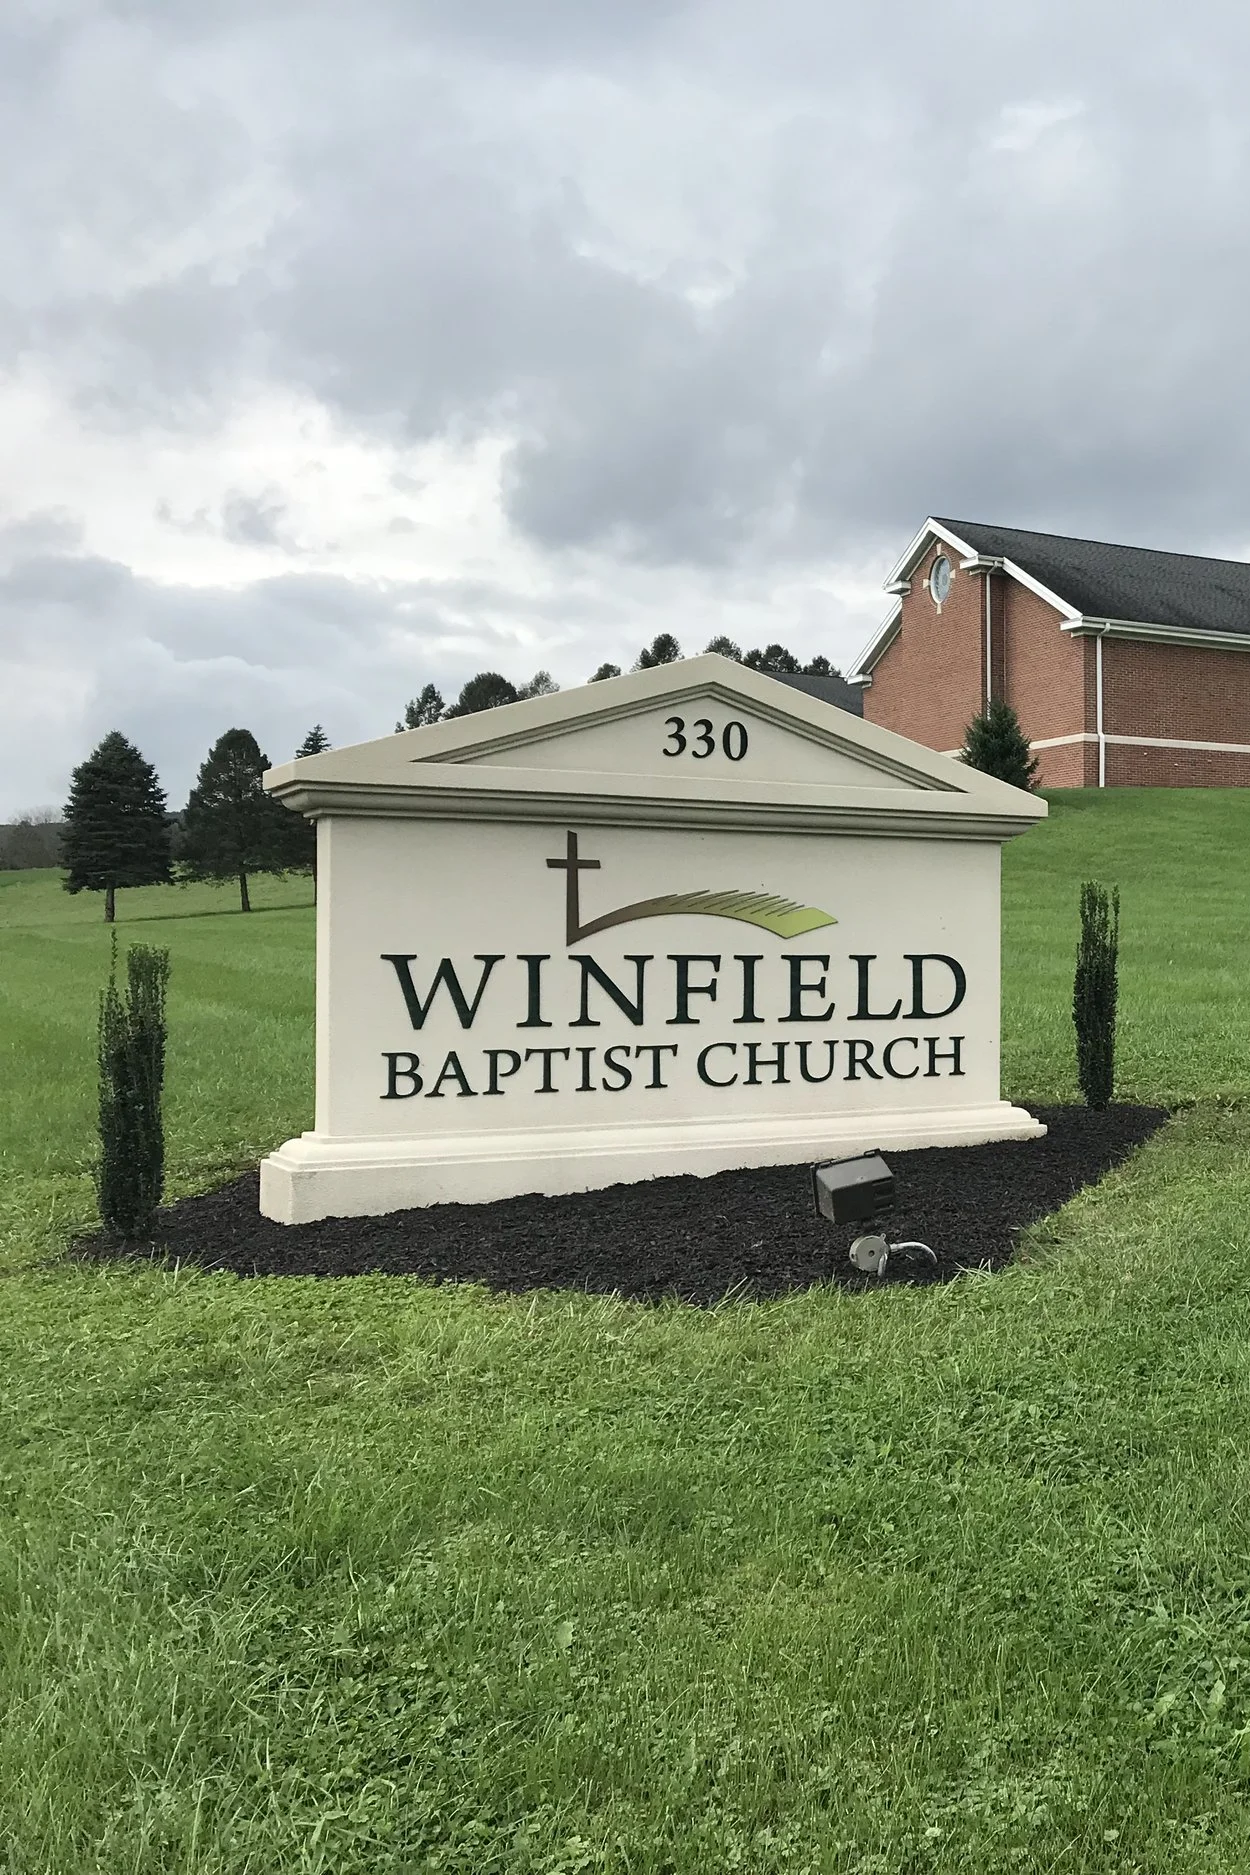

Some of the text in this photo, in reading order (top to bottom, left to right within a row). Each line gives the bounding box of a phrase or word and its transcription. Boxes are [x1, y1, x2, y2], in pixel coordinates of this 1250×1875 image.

[662, 716, 749, 762] 330
[380, 953, 967, 1030] WINFIELD
[379, 1035, 966, 1100] BAPTIST CHURCH
